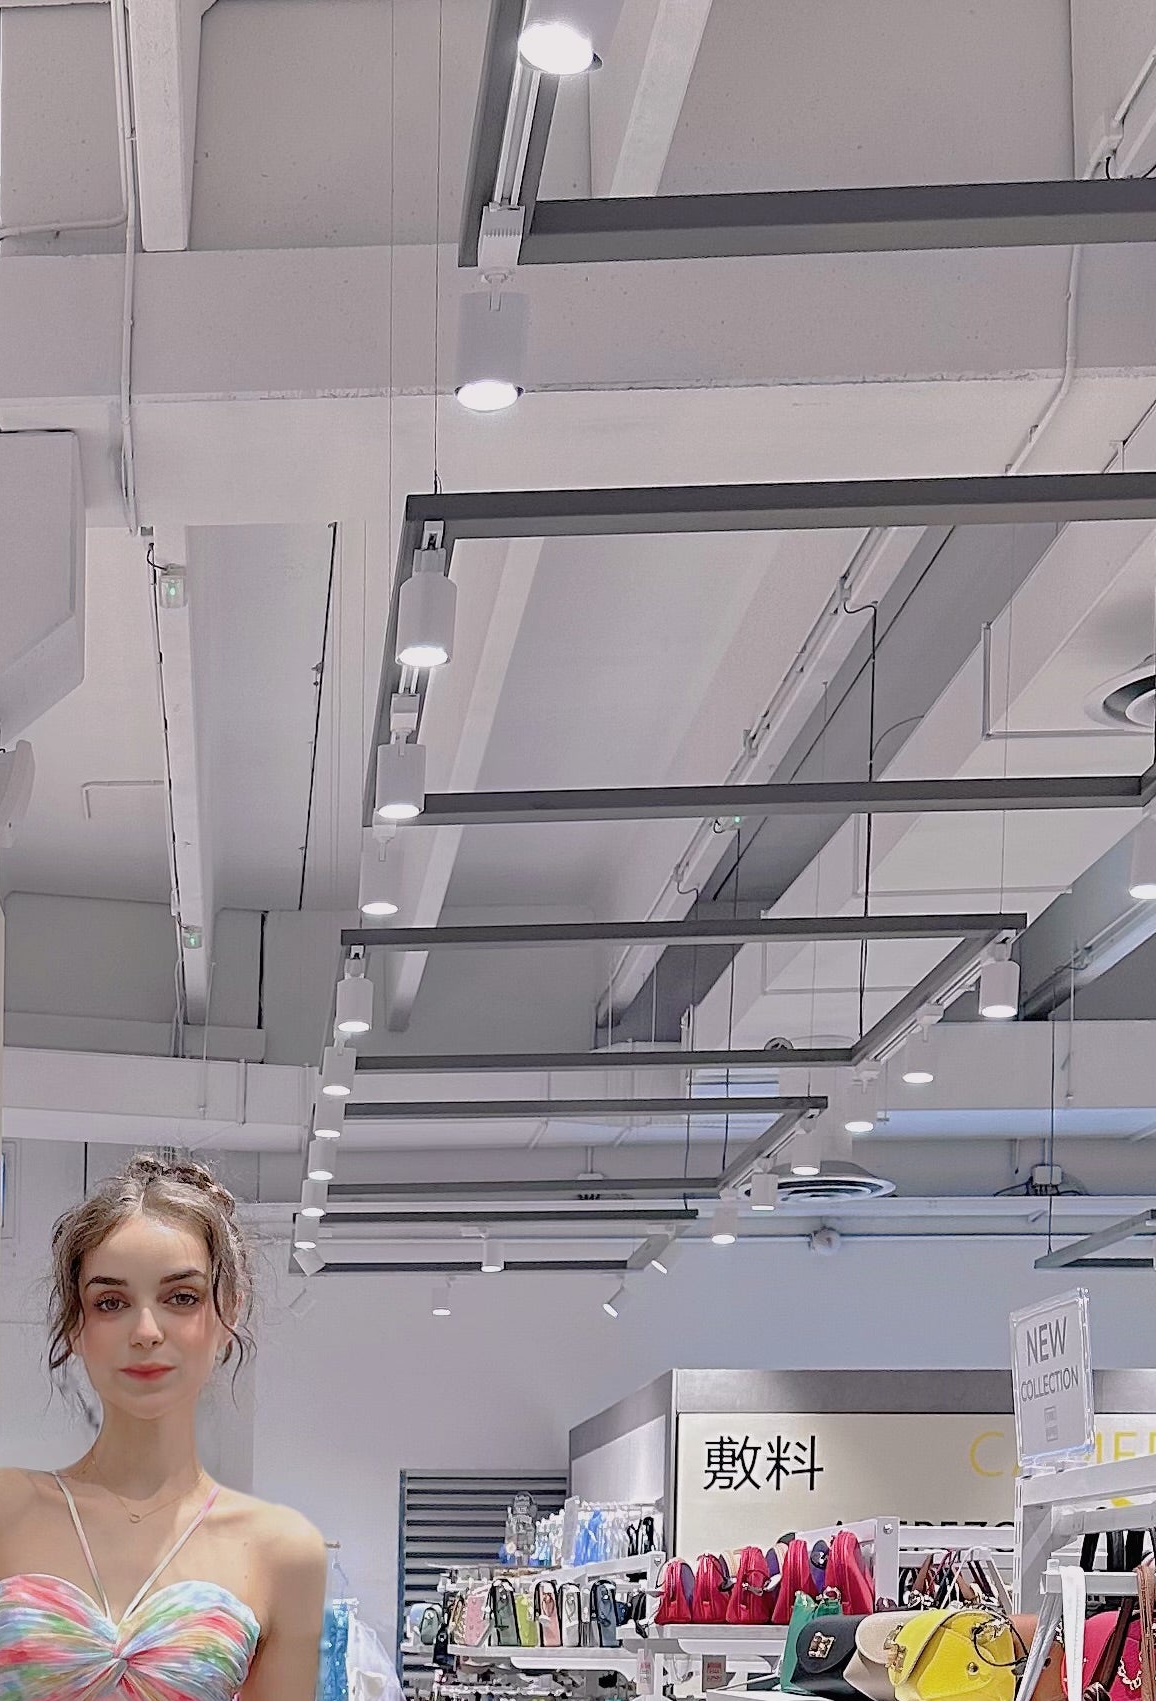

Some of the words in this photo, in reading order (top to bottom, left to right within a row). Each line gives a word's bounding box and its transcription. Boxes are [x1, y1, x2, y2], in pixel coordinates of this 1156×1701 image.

[1026, 1316, 1067, 1367] NEW
[1020, 1365, 1079, 1402] COLLECTION
[703, 1435, 824, 1491] 敷料
